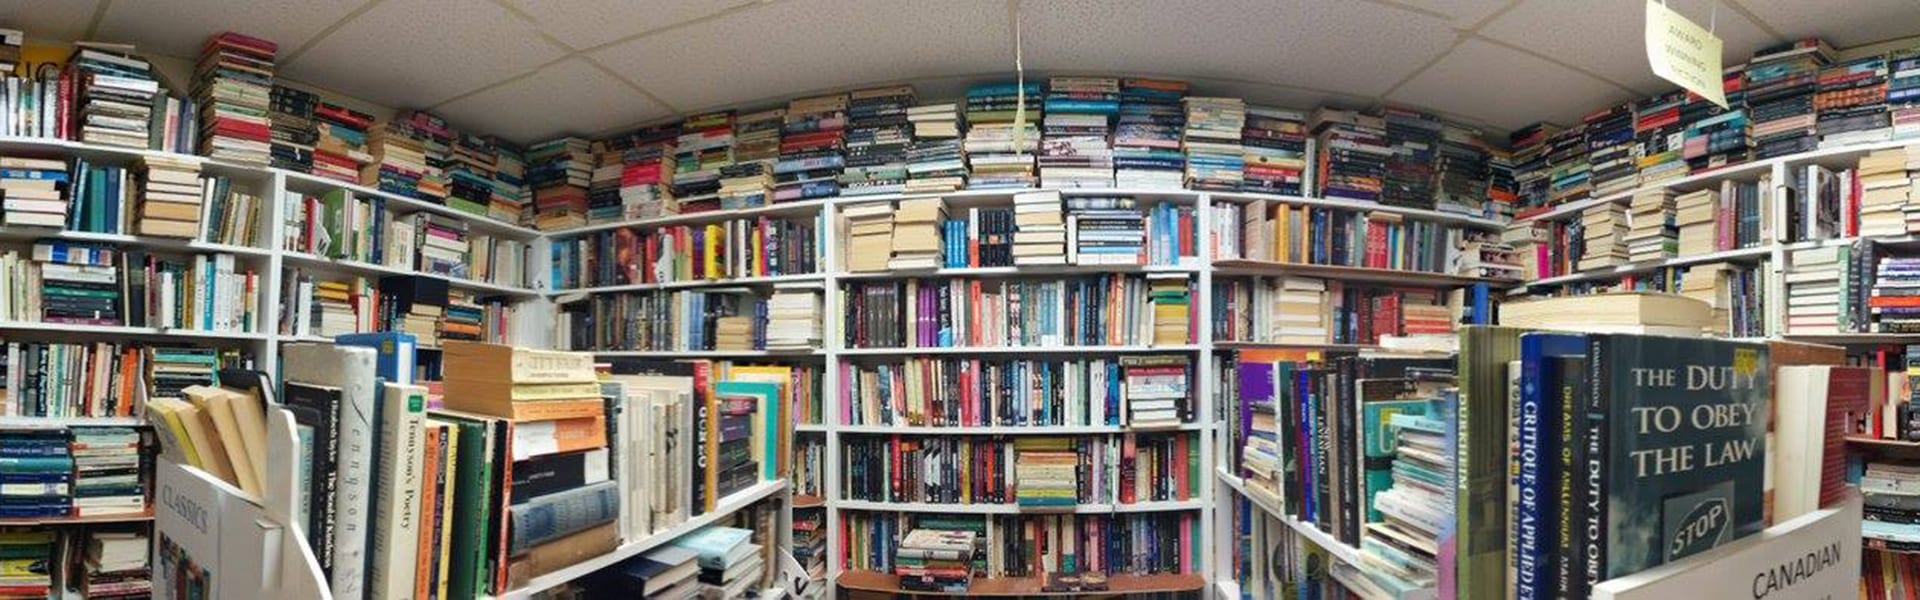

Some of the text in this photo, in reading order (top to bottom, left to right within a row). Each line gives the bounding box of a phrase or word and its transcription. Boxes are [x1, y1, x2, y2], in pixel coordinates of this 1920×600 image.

[1631, 365, 1759, 390] THE DUTY
[1563, 386, 1572, 442] DREAMS
[1631, 403, 1756, 434] TO OBEY
[1317, 417, 1326, 475] LEVIATHAN
[1458, 393, 1469, 490] DURKHEIM
[1522, 401, 1537, 485] CRITIQUE
[1561, 447, 1571, 465] OF
[1589, 427, 1599, 454] THE
[1629, 438, 1756, 477] THE LAW
[400, 419, 420, 531] Tennyson's Poetry
[1521, 488, 1536, 512] OF
[1588, 459, 1600, 514] DUTY
[163, 484, 208, 534] CLASSICS
[1588, 517, 1599, 540] TO
[1672, 504, 1722, 554] STOP
[1520, 514, 1535, 583] APPLIED
[1752, 541, 1841, 599] CANADIAN
